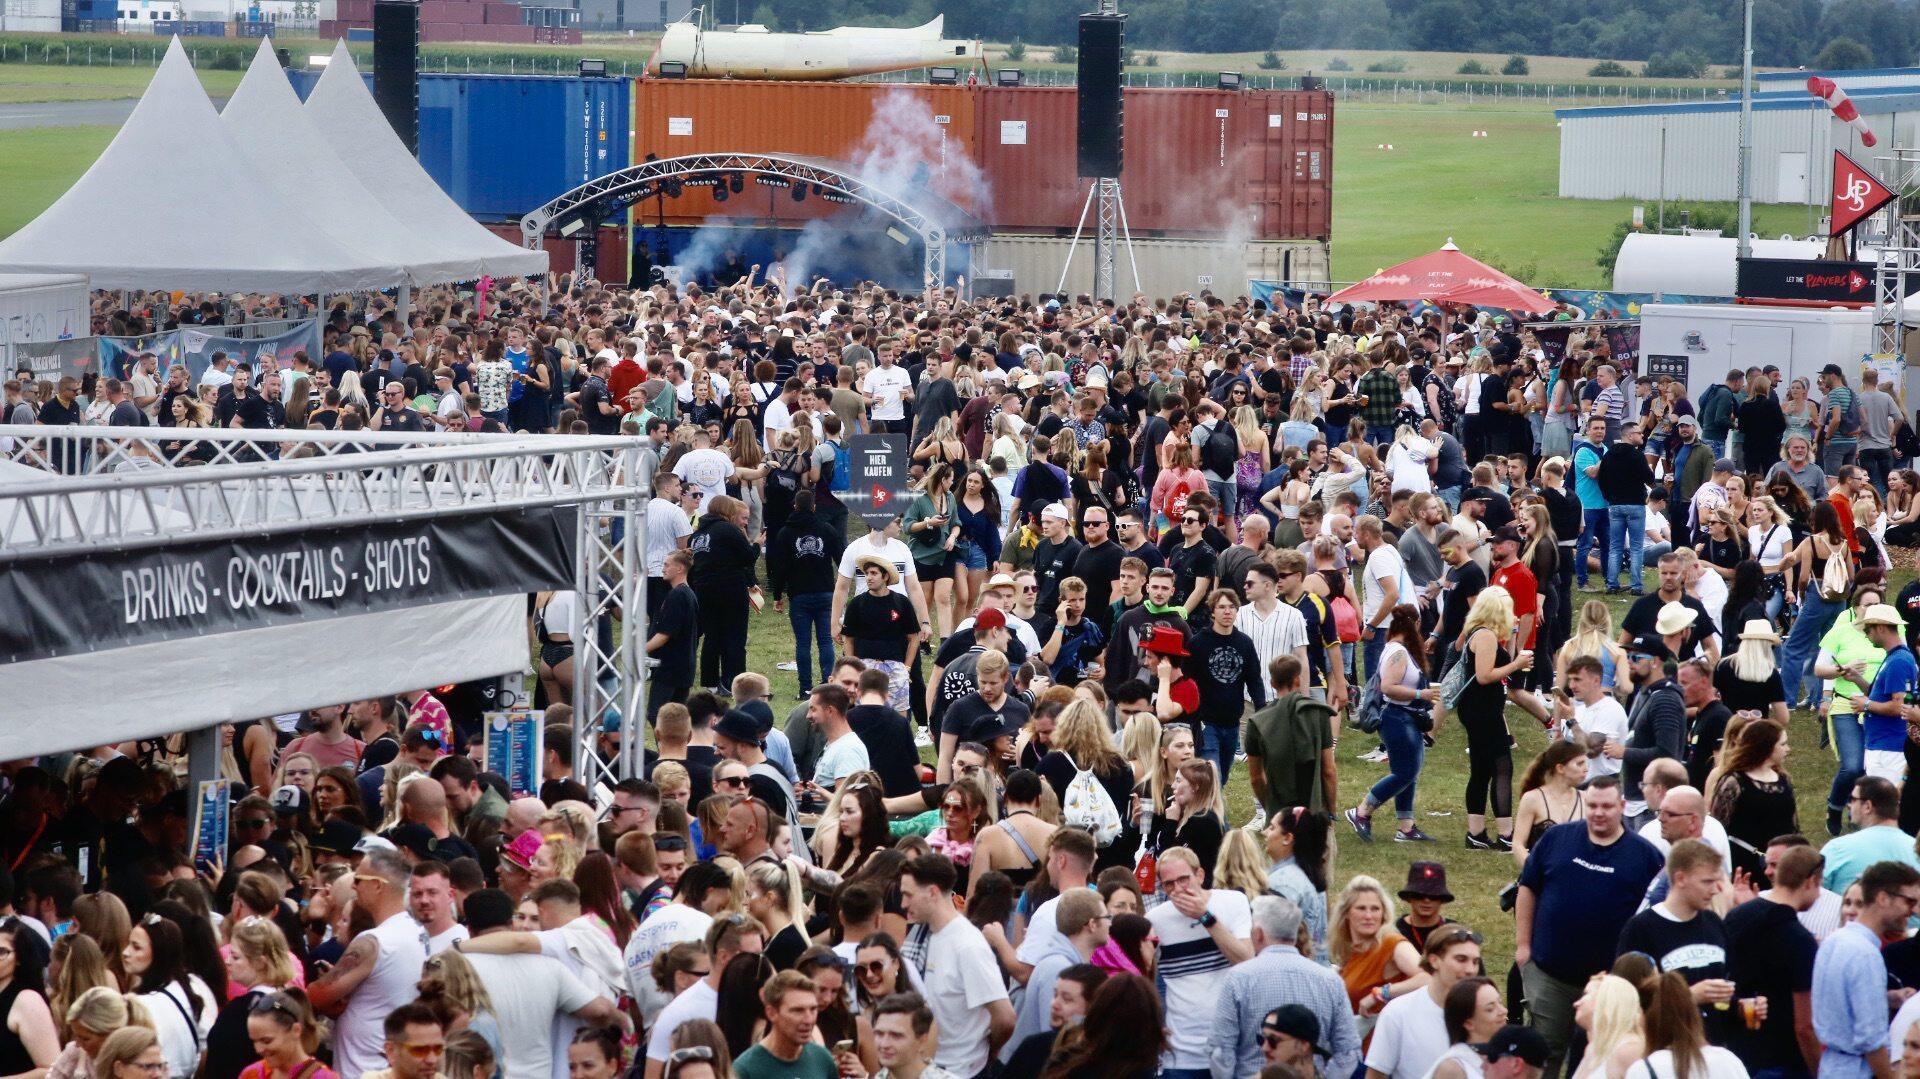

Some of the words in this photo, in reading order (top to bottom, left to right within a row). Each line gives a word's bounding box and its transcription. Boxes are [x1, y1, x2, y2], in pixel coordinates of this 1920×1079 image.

[1805, 274, 1847, 289] PLAYERS
[869, 454, 887, 465] HIER
[864, 466, 892, 477] KAUFEN
[122, 561, 207, 624] DRINKS
[228, 546, 346, 610] COCKTAILS
[364, 536, 430, 593] SHOTS
